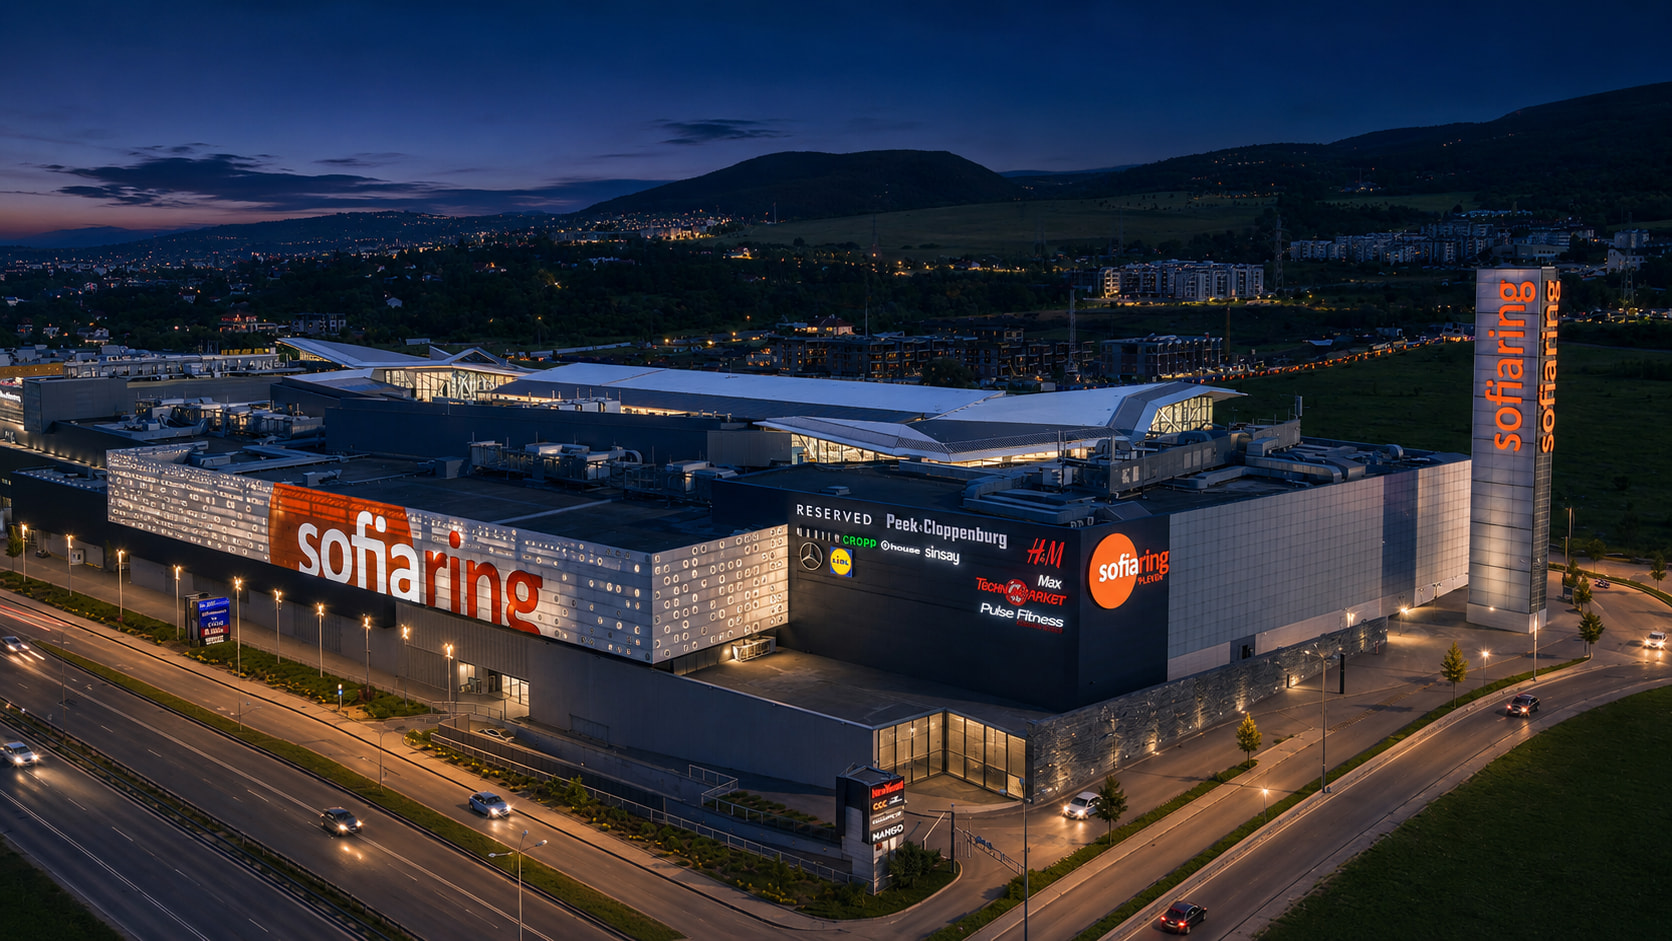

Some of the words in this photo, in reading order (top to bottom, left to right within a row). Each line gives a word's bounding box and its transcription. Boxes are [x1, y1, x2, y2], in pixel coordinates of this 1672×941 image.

[1484, 280, 1536, 452] sofiaring
[1538, 280, 1561, 453] sofiaring
[796, 503, 872, 526] RESERVED
[842, 534, 877, 549] CROPP
[890, 543, 921, 555] house
[1027, 537, 1065, 569] H&M
[924, 545, 960, 566] sinsay
[1099, 549, 1170, 582] sofiaring
[298, 510, 543, 636] sofiaring
[1037, 574, 1062, 590] Max
[980, 602, 1015, 618] Pulse
[1016, 608, 1065, 628] Fitness
[872, 799, 888, 811] CCC
[872, 824, 904, 842] MANGO
